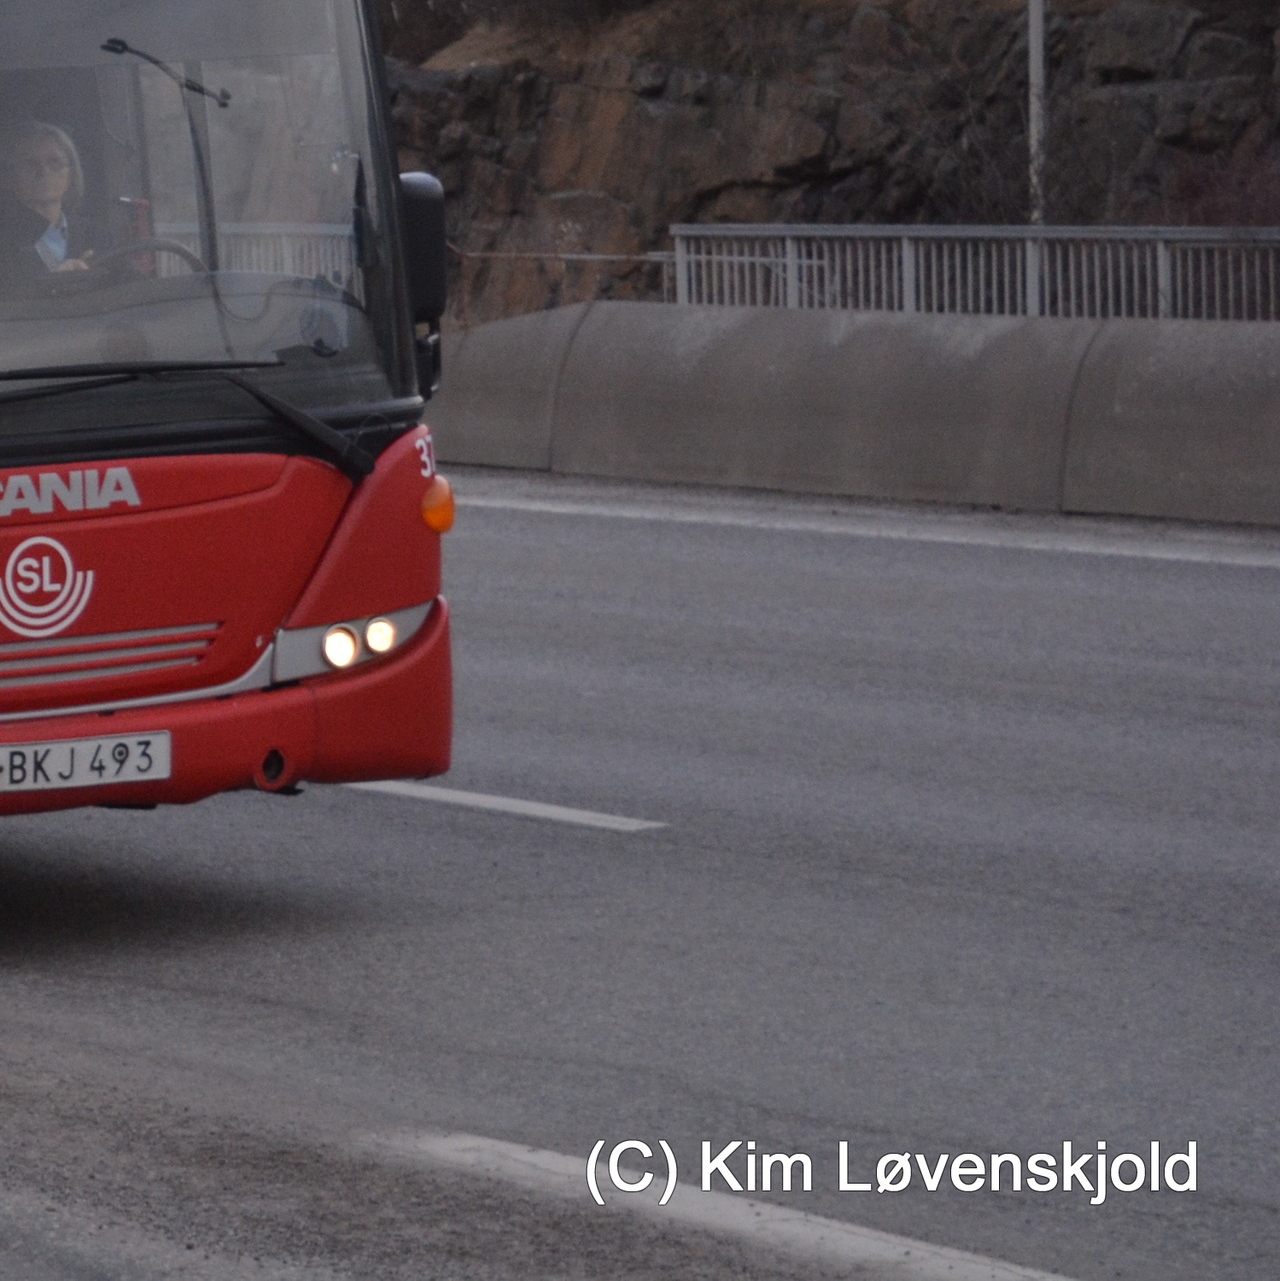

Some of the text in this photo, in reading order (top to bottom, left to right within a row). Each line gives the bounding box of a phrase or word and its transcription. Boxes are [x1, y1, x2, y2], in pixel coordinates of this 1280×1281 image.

[16, 555, 62, 594] SL
[8, 747, 75, 785] BKJ
[89, 739, 154, 779] 493
